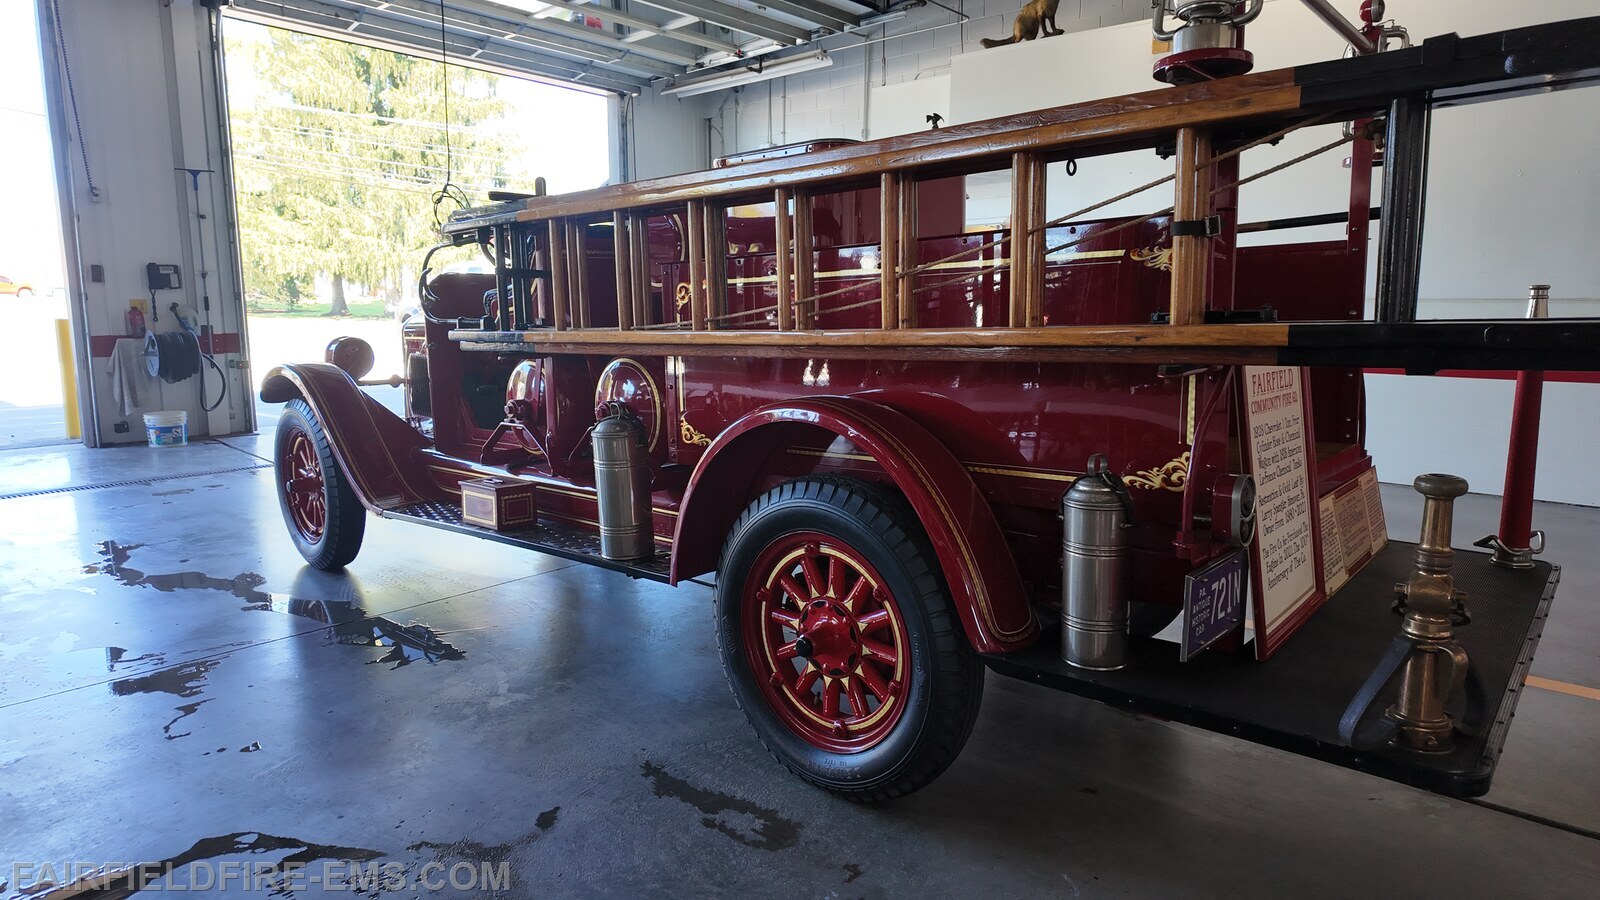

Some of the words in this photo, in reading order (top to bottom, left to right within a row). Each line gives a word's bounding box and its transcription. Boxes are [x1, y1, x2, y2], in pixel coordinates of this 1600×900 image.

[1252, 369, 1293, 394] FAIRFIELD
[1251, 395, 1281, 414] COMMUNITY
[1282, 392, 1292, 408] FIRE
[1265, 420, 1281, 436] Chevrolet
[1257, 438, 1272, 454] Cylinder
[1273, 435, 1281, 448] Hose
[1286, 429, 1301, 442] Chemical
[1258, 455, 1271, 470] Wagon
[1288, 444, 1301, 457] American
[1276, 461, 1291, 477] Chemical
[1259, 489, 1279, 506] Restoration
[1262, 509, 1273, 521] Larry
[1263, 524, 1275, 536] Owner
[1266, 558, 1279, 574] Engine
[1268, 568, 1289, 590] Anniversary
[1192, 595, 1211, 614] ANTIQUE
[1211, 569, 1241, 625] 721N
[1191, 608, 1210, 628] HISTORIC
[1195, 623, 1205, 637] CAR
